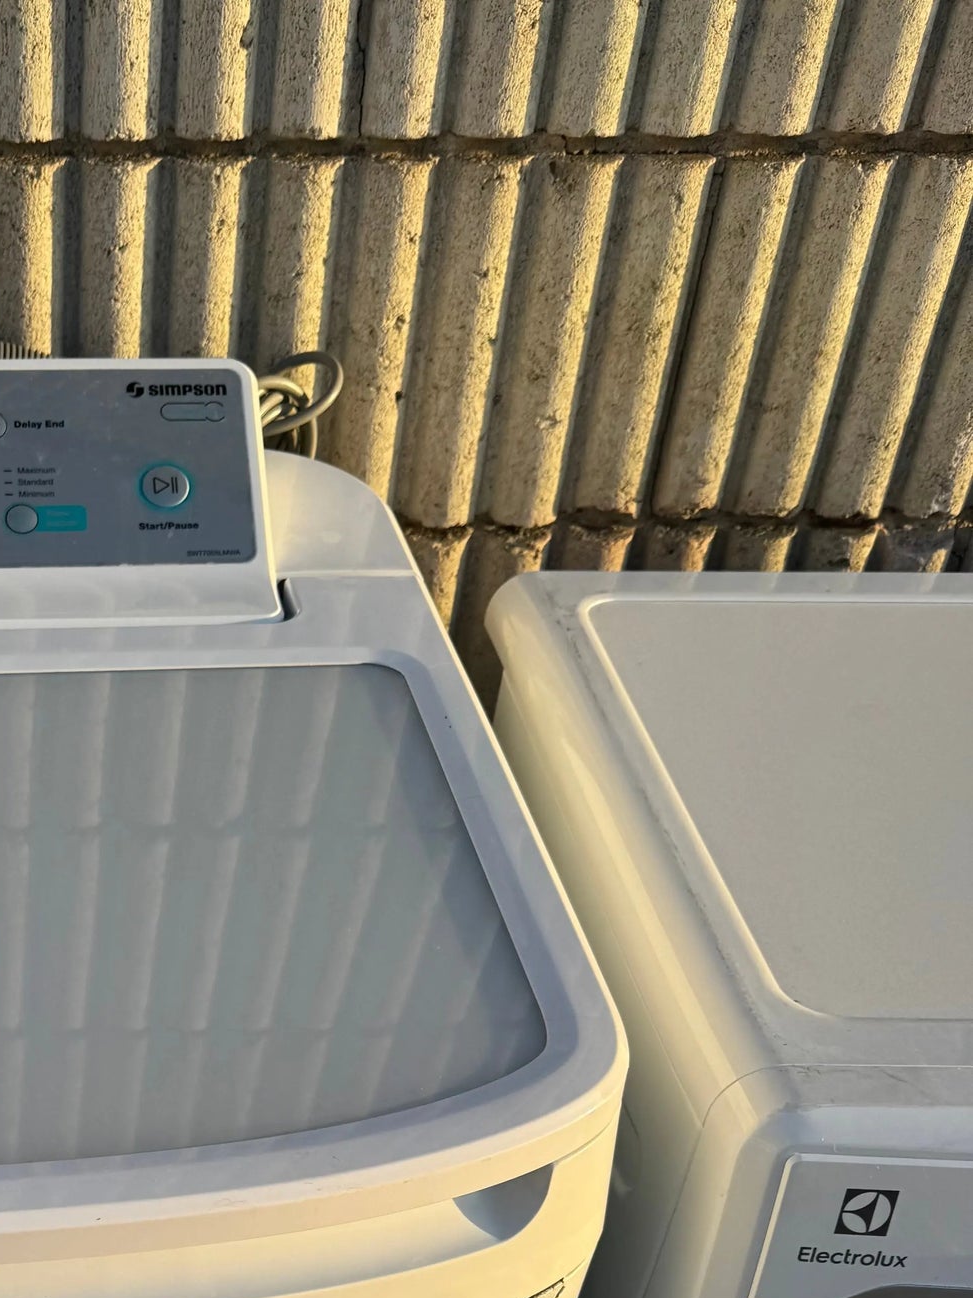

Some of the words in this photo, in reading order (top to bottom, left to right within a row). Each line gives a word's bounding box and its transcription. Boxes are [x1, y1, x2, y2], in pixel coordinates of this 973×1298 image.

[14, 420, 42, 429] Delay
[45, 420, 65, 428] End
[139, 522, 199, 530] Start/Pause
[797, 1246, 908, 1268] Electrolux
